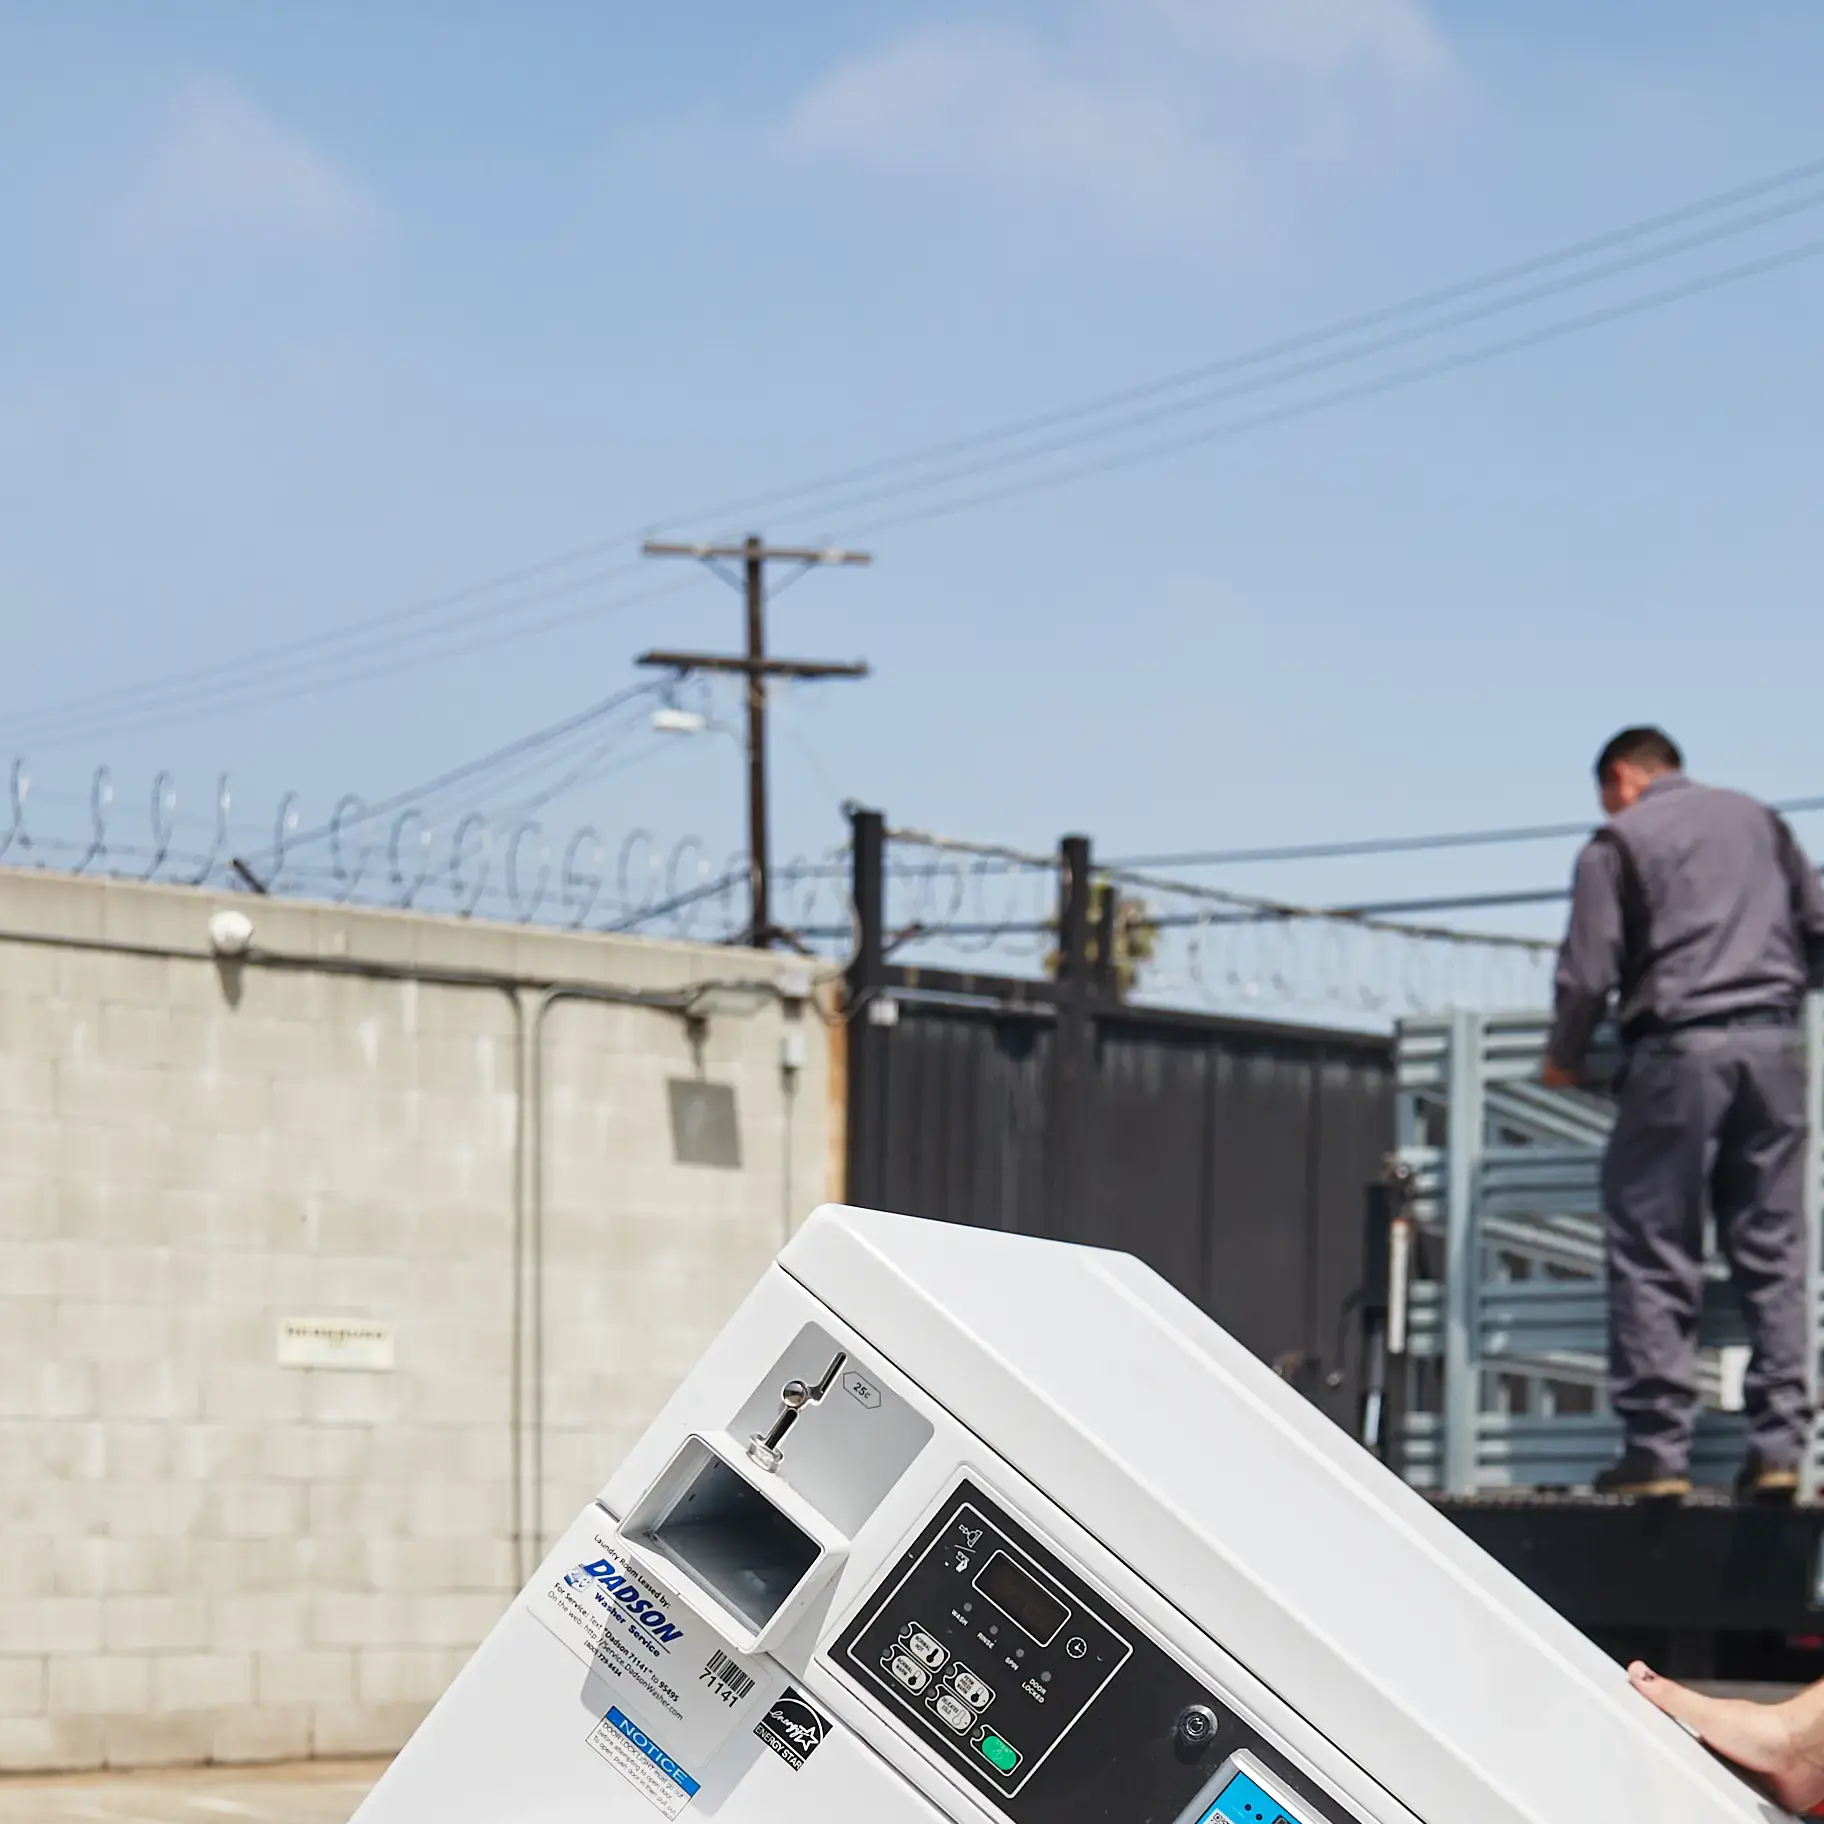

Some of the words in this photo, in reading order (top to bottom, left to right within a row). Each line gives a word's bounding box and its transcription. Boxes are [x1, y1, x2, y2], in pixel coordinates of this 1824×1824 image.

[593, 1535, 620, 1560] Laundry
[618, 1558, 639, 1578] Room
[637, 1576, 661, 1598] Leased
[658, 1596, 671, 1609] by:
[547, 1591, 558, 1601] On
[557, 1600, 569, 1612] the
[567, 1610, 584, 1626] web:
[584, 1554, 683, 1646] DADSON
[950, 1609, 967, 1625] WASH
[553, 1583, 565, 1595] For
[563, 1593, 589, 1617] Service:
[588, 1616, 603, 1630] Text
[650, 1674, 660, 1683] to
[658, 1681, 679, 1701] 95495
[593, 1592, 626, 1624] Washer
[627, 1625, 661, 1657] Service
[976, 1632, 994, 1649] RINSE
[1004, 1657, 1018, 1670] SPIN
[698, 1668, 738, 1707] 71141
[1020, 1681, 1044, 1703] LOCKED
[1028, 1678, 1046, 1695] DOOR
[766, 1706, 803, 1740] energy
[602, 1722, 621, 1740] DOOR
[620, 1739, 636, 1754] LOCK
[635, 1753, 654, 1771] LIGHT
[653, 1770, 667, 1783] must
[665, 1782, 674, 1791] go
[619, 1719, 687, 1783] NOTICE
[755, 1725, 783, 1752] ENERGY
[781, 1749, 802, 1769] STAR
